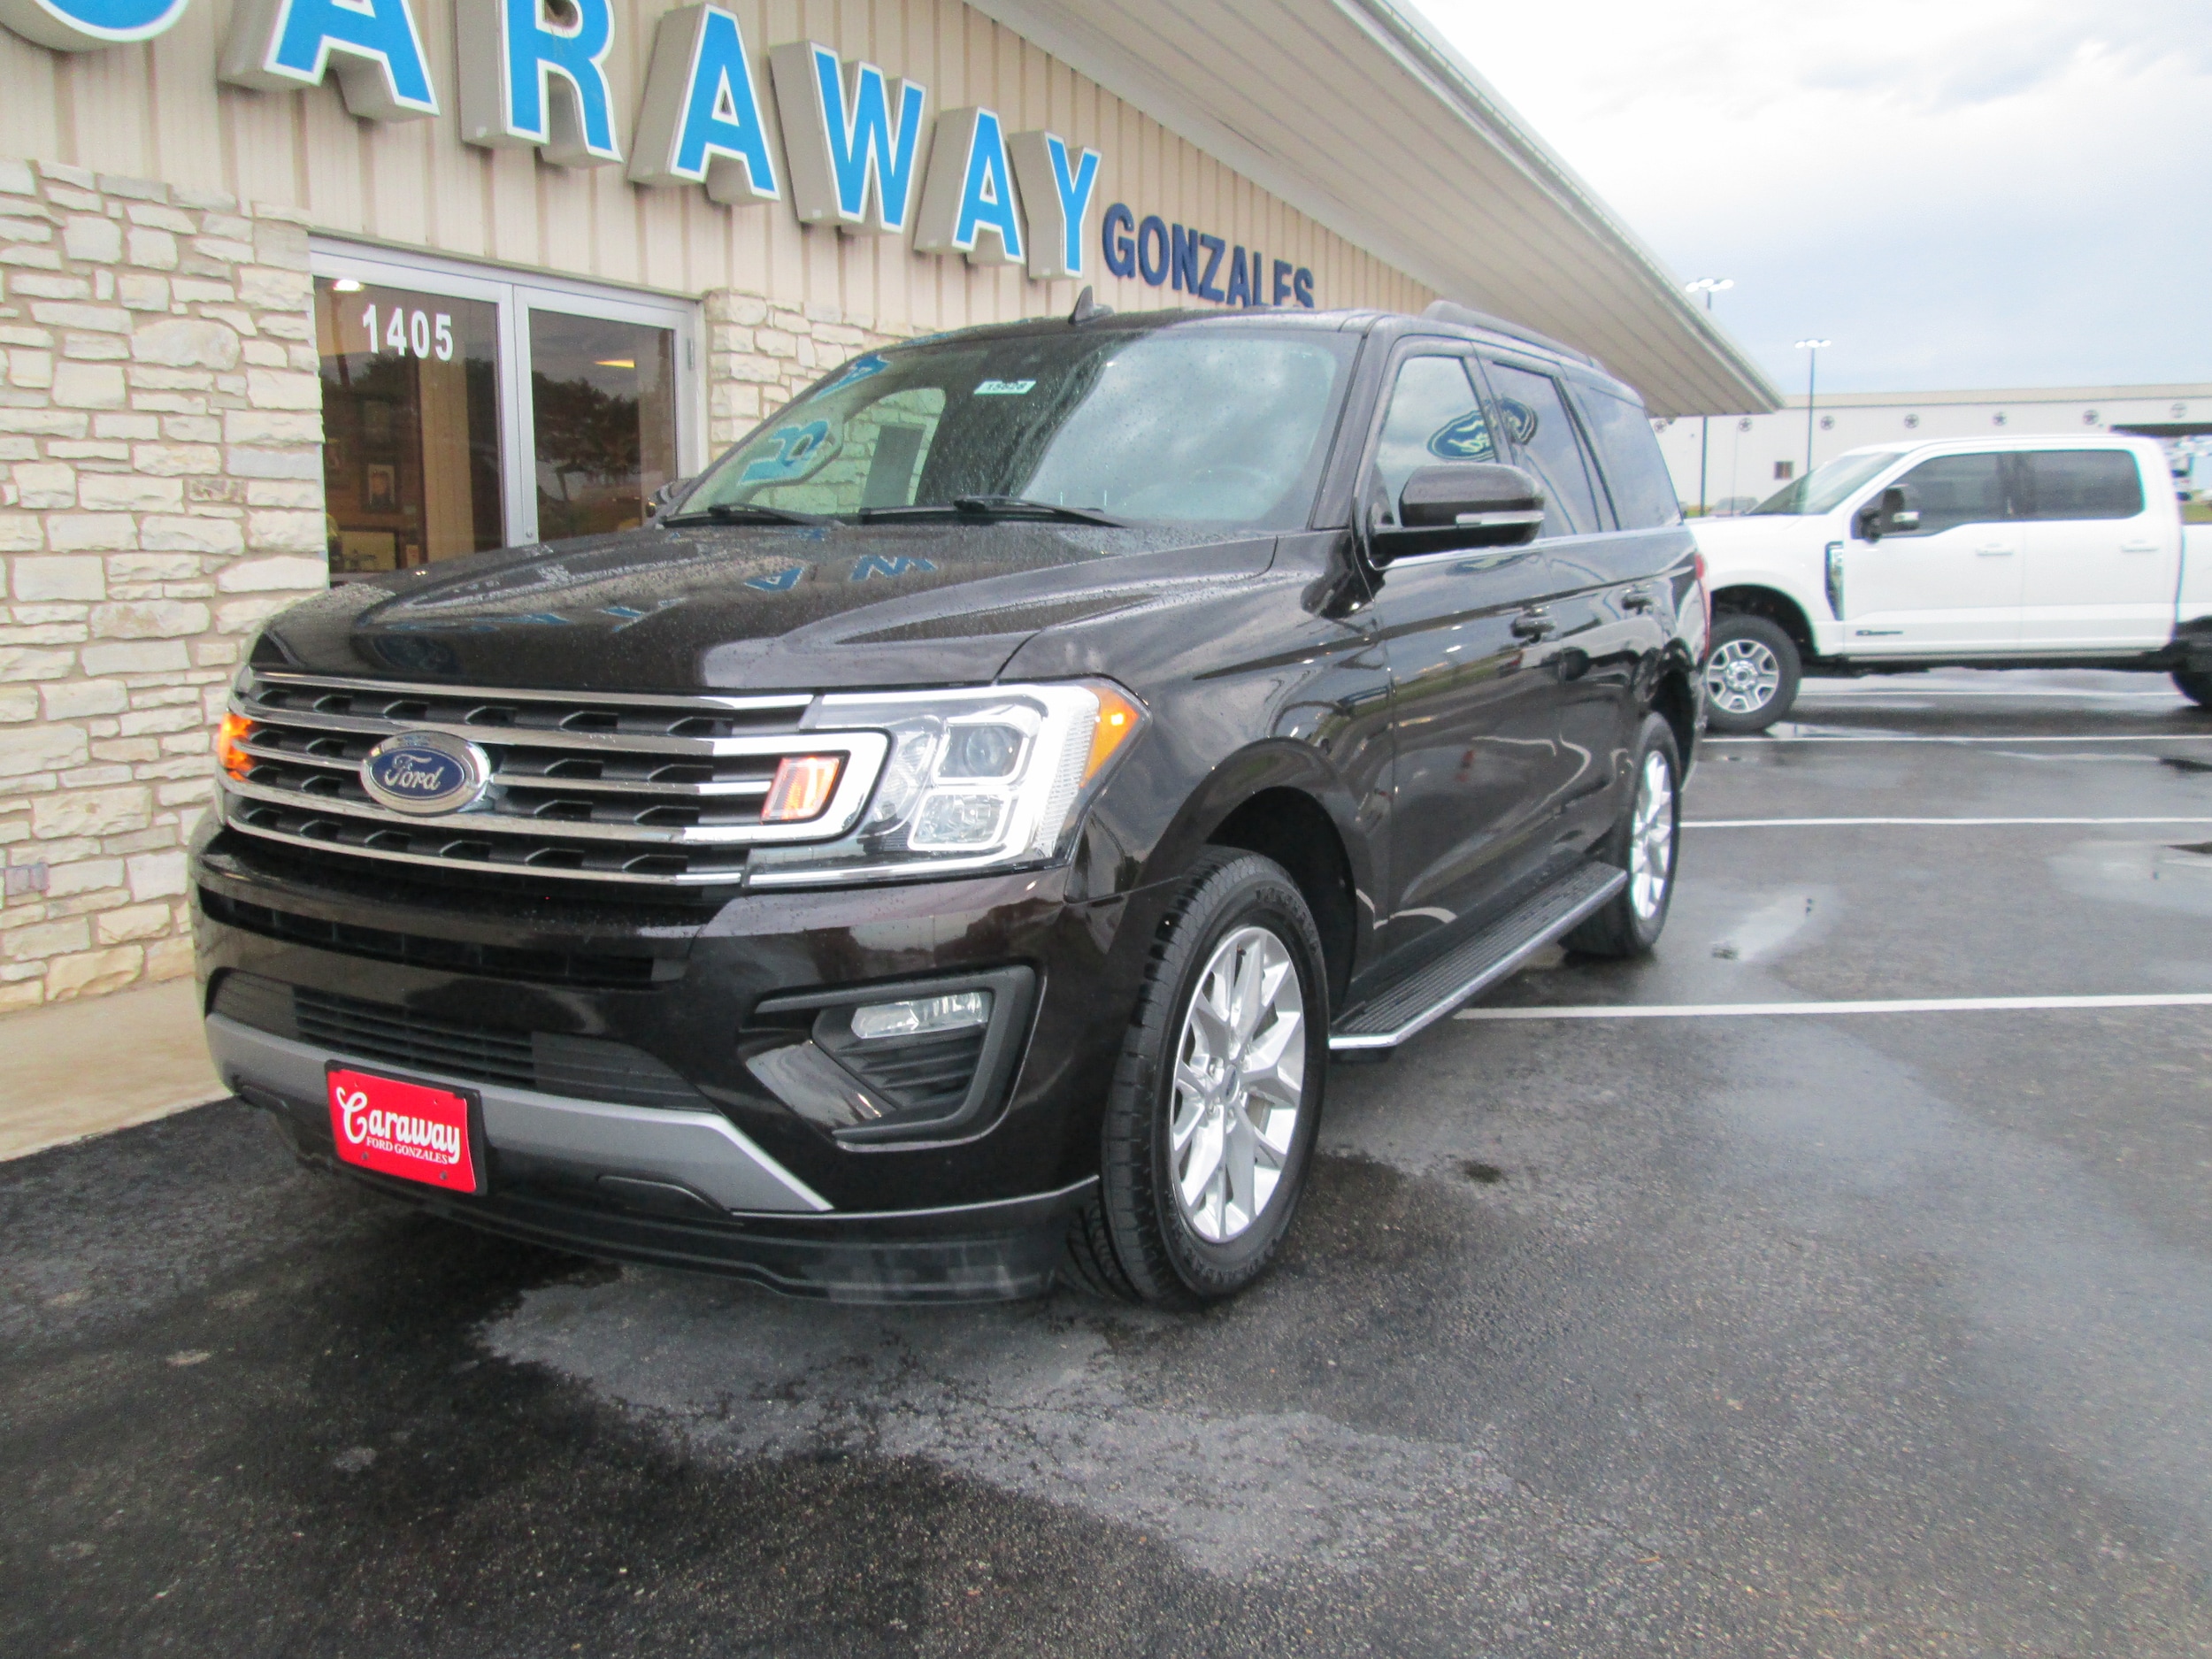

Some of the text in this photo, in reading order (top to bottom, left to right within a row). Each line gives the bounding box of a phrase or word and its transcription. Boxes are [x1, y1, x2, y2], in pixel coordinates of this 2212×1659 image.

[0, 0, 1102, 279] ARAWAY
[1102, 202, 1315, 308] GONZALES
[362, 303, 453, 361] 1405
[384, 753, 444, 791] Ford
[336, 1087, 461, 1164] Caraway
[365, 1136, 449, 1164] FORD GONZALES
